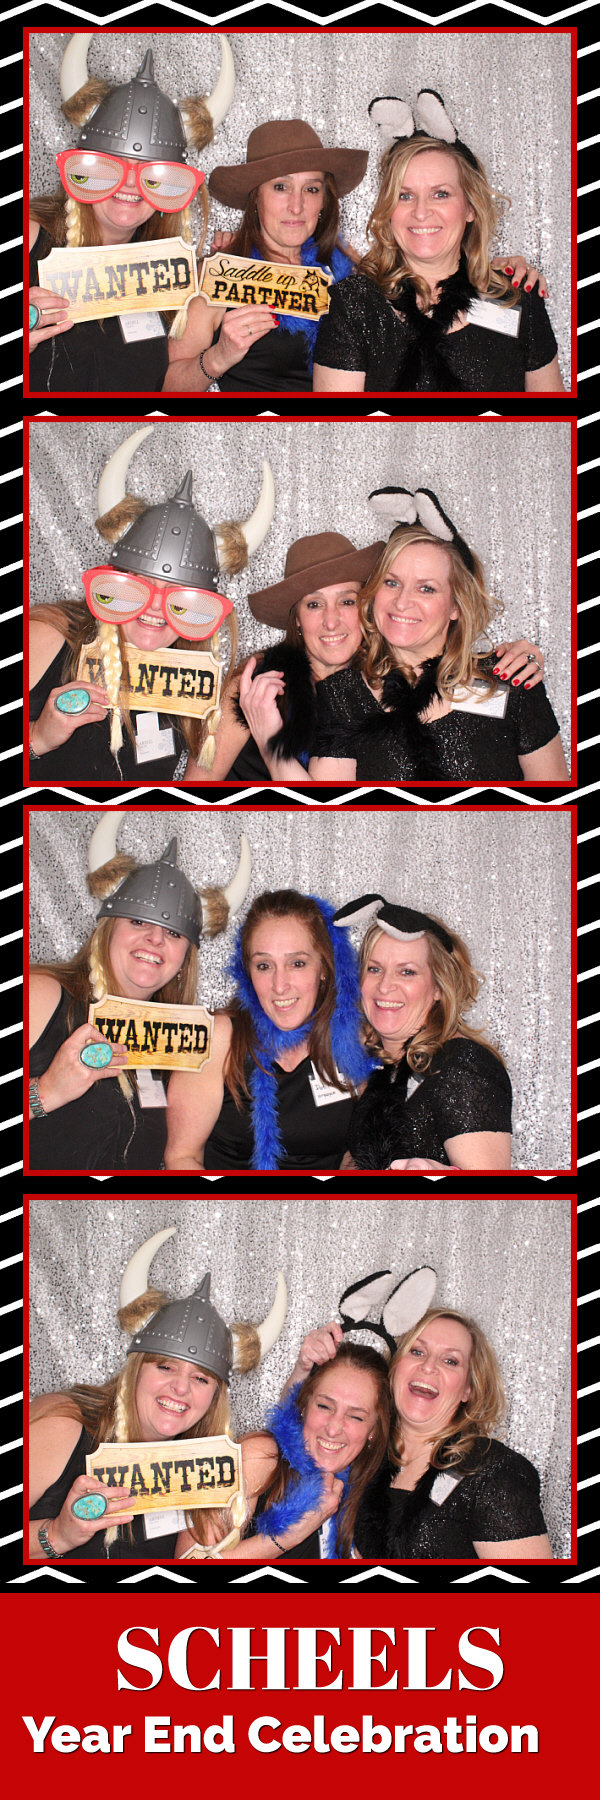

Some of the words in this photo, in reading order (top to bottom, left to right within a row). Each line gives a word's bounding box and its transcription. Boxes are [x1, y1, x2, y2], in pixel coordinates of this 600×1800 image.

[46, 257, 192, 305] WANTED
[209, 259, 273, 282] Saddle
[276, 275, 297, 289] up
[211, 280, 318, 314] PARTNER
[95, 1017, 208, 1054] WANTED
[93, 1455, 236, 1497] WANTED
